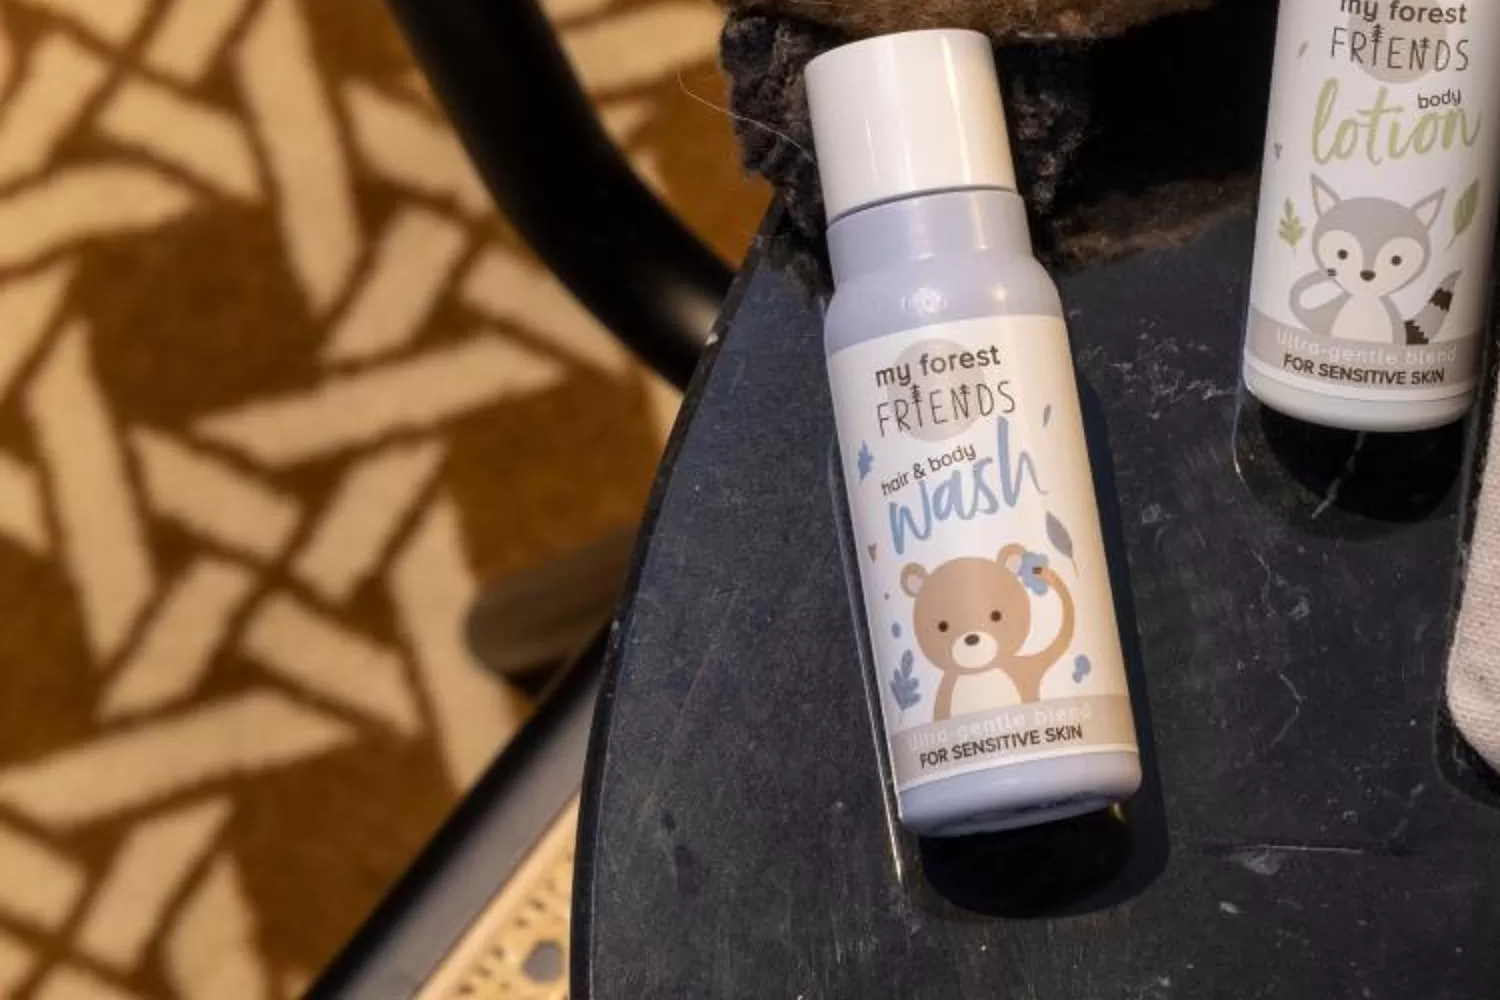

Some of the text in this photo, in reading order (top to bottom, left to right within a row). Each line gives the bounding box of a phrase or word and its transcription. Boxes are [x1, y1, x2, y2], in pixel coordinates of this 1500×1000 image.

[1389, 0, 1467, 24] forest
[1330, 23, 1470, 72] FRIENDS
[1311, 76, 1482, 166] lotion
[1417, 88, 1462, 109] body
[875, 345, 1001, 388] my forest
[1284, 352, 1445, 386] FOR SENSITIVE SKIN
[876, 380, 1016, 438] FRIENDS
[880, 443, 977, 496] hair & body
[888, 415, 1049, 555] wash
[919, 722, 1083, 769] FOR SENSITIVE SKIN
